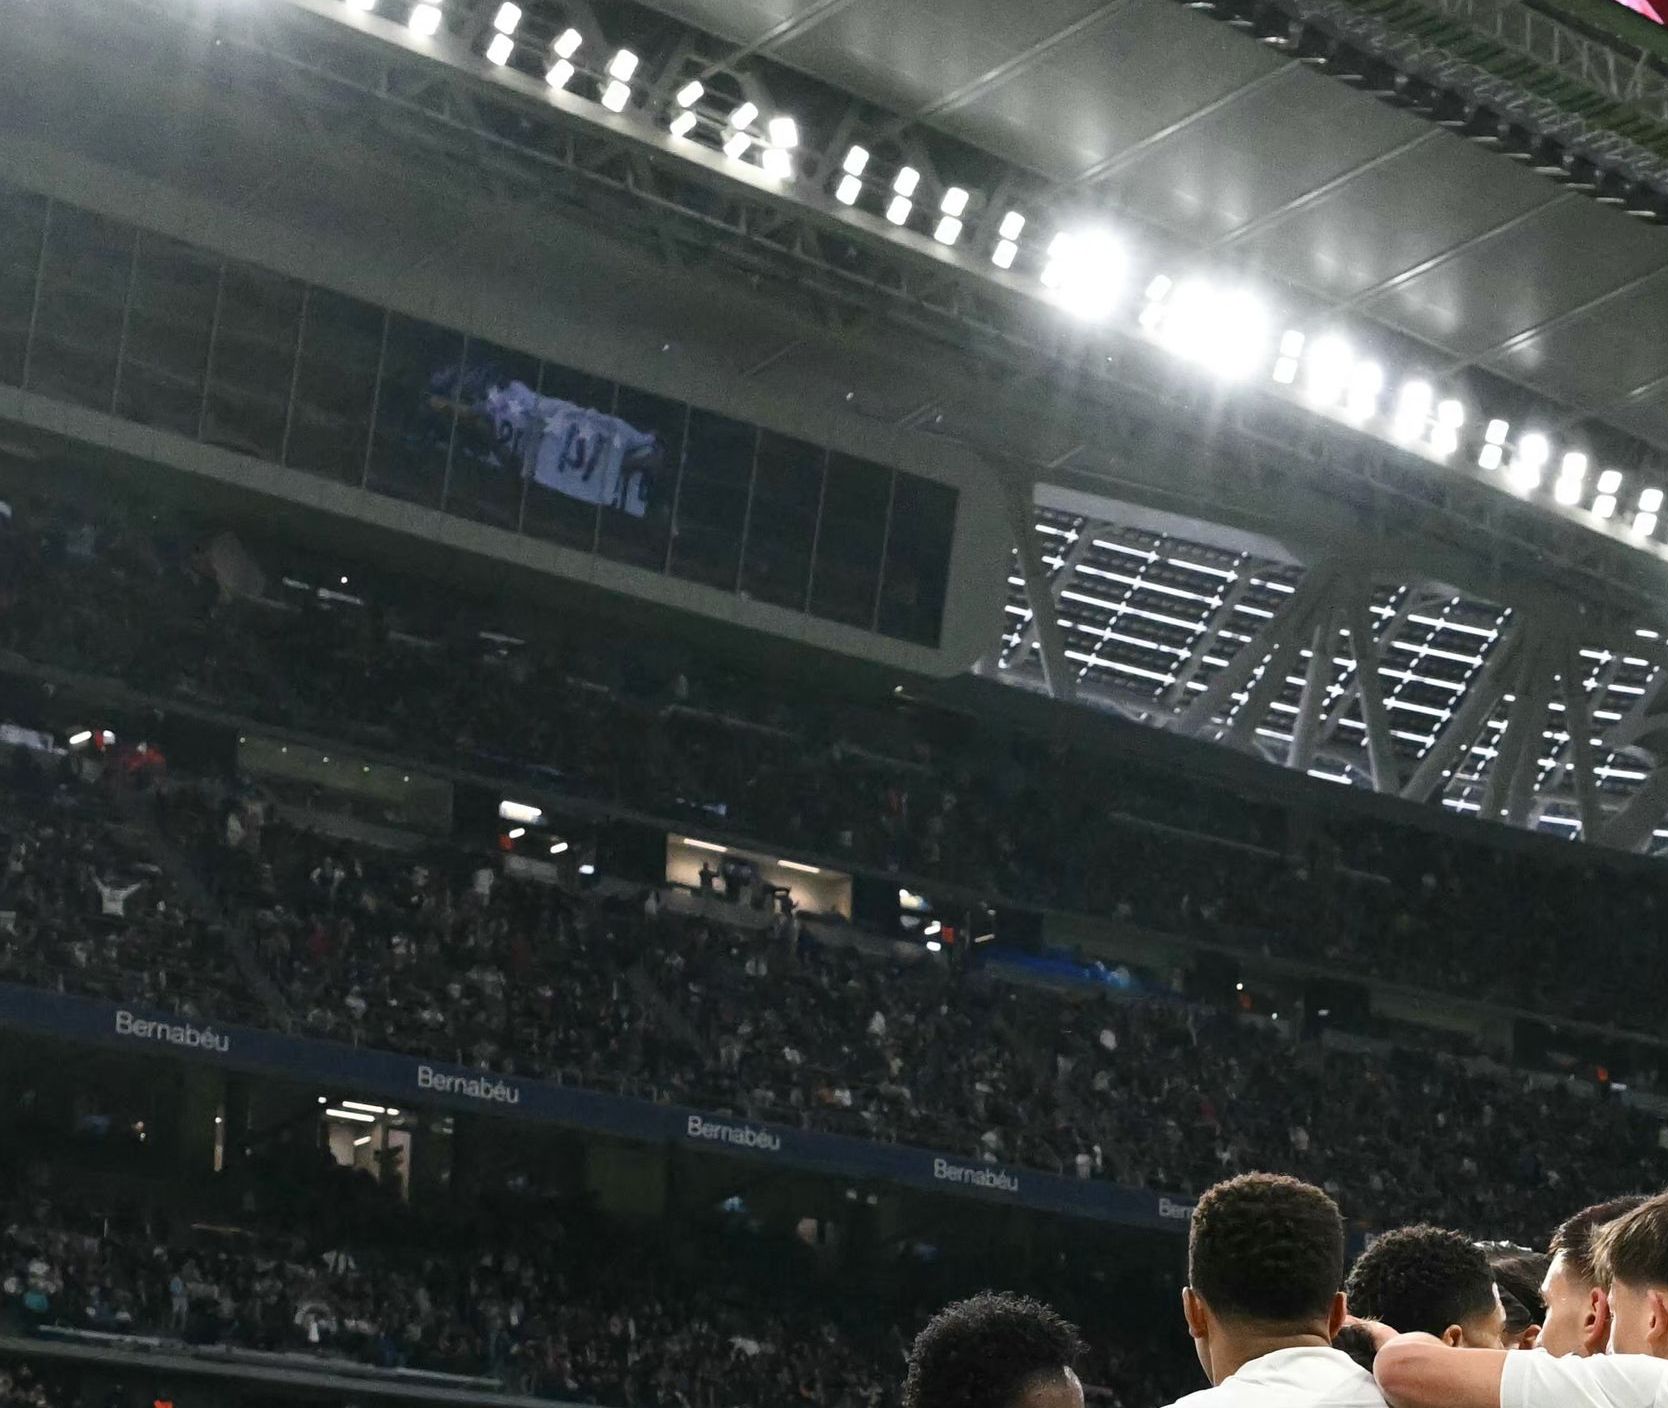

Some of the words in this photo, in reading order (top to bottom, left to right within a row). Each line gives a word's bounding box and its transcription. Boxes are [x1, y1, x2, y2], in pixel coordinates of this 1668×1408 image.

[115, 1010, 230, 1053] Bernabéu
[416, 1065, 520, 1105] Bernabéu
[687, 1115, 781, 1152] Bernabéu
[933, 1158, 1020, 1193] Bernabéu
